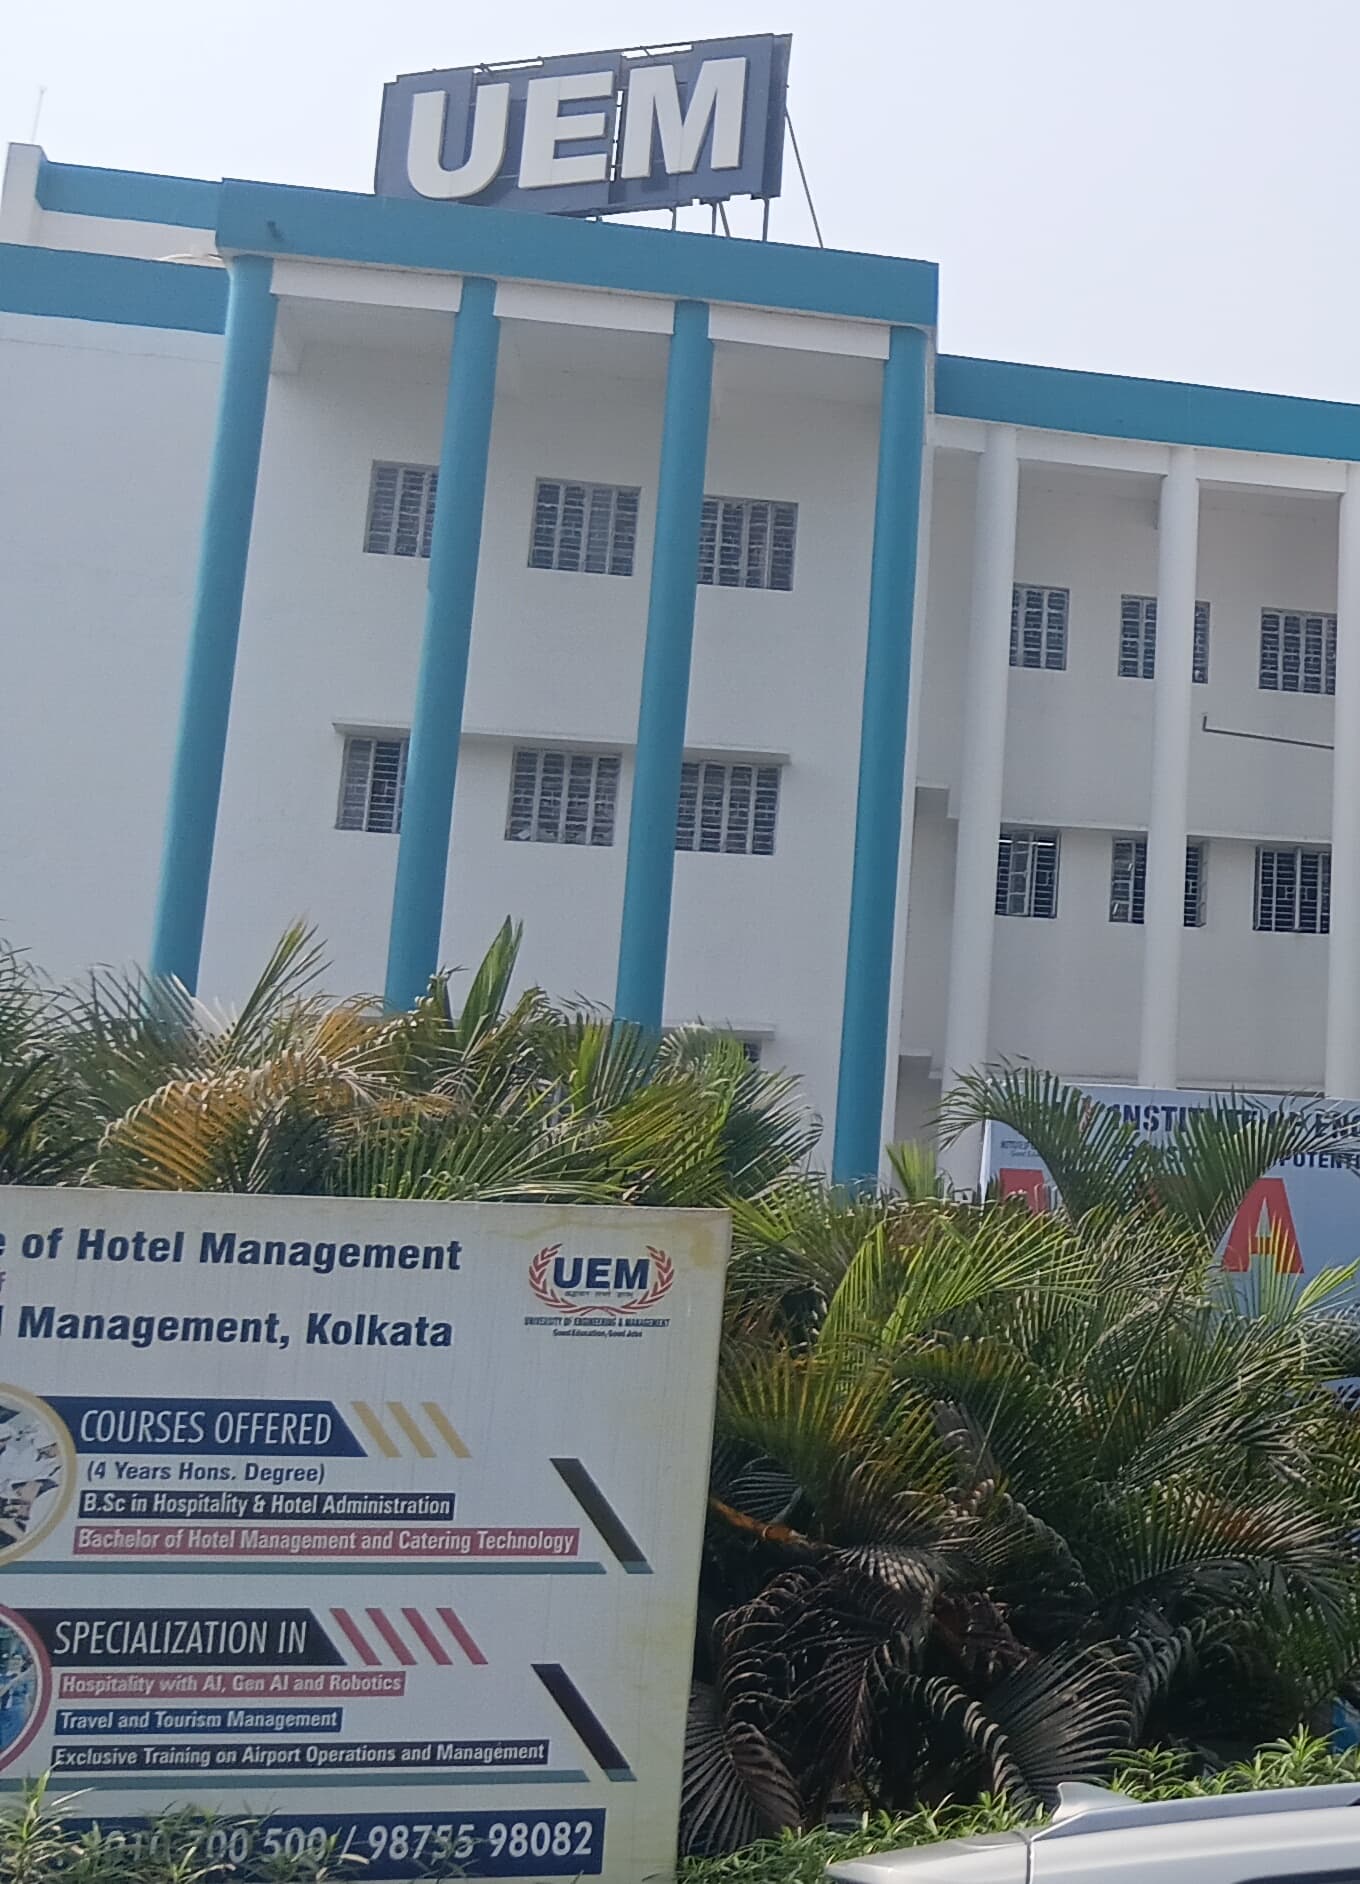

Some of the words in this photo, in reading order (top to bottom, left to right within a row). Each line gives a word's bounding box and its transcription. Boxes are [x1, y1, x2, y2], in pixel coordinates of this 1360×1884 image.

[407, 56, 747, 200] UEM
[21, 1226, 63, 1260] of
[76, 1228, 185, 1263] Hotel
[199, 1232, 463, 1275] Management
[553, 1256, 651, 1290] UEM
[17, 1305, 291, 1350] Management,
[305, 1312, 454, 1348] Kolkata
[524, 1316, 563, 1326] UNIVERSITY
[624, 1318, 671, 1328] MANAGEMENT
[80, 1409, 206, 1444] COURSES
[214, 1411, 333, 1446] OFFERED
[86, 1460, 106, 1483] (4
[115, 1461, 172, 1480] Years
[178, 1461, 237, 1482] Hons.
[244, 1461, 326, 1486] Degree)
[83, 1492, 126, 1513] B.Sc
[131, 1493, 148, 1513] in
[152, 1492, 248, 1518] Hospitality
[253, 1495, 267, 1514] &
[271, 1494, 317, 1514] Hotel
[322, 1494, 451, 1515] Administration
[78, 1527, 159, 1549] Bachelor
[164, 1528, 184, 1549] of
[187, 1529, 235, 1549] Hotel
[239, 1529, 357, 1553] Management
[361, 1530, 393, 1550] and
[398, 1530, 472, 1554] Catering
[476, 1530, 575, 1554] Technology
[53, 1620, 269, 1655] SPECIALIZATION
[277, 1620, 308, 1654] IN
[62, 1675, 155, 1696] Hospitality
[158, 1675, 198, 1692] with
[201, 1675, 227, 1694] AI,
[231, 1674, 265, 1692] Gen
[268, 1674, 289, 1692] AI
[293, 1674, 325, 1691] and
[328, 1673, 402, 1692] Robotics
[60, 1711, 113, 1729] Travel
[117, 1710, 151, 1728] and
[154, 1710, 222, 1728] Tourism
[226, 1710, 338, 1731] Management
[55, 1748, 138, 1766] Exclusive
[143, 1746, 211, 1767] Training
[215, 1749, 237, 1764] on
[241, 1745, 301, 1766] Airport
[305, 1744, 396, 1766] Operations
[400, 1743, 431, 1761] and
[436, 1742, 546, 1763] Management
[263, 1826, 328, 1863] 500
[368, 1823, 475, 1861] 98755
[488, 1820, 594, 1858] 98082
